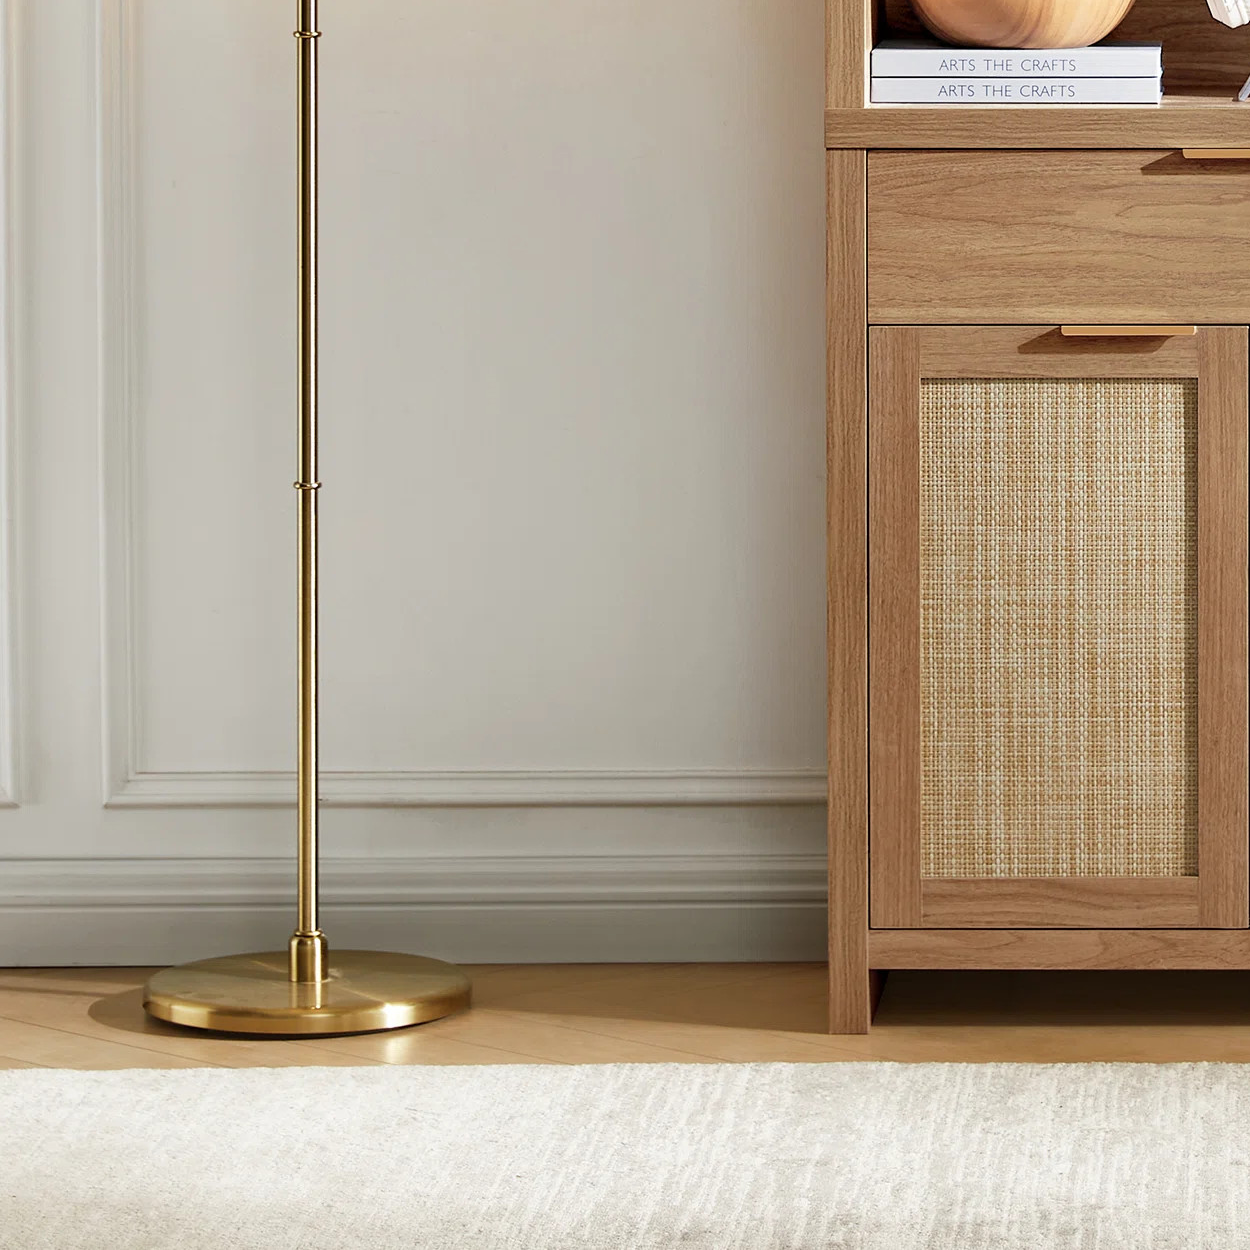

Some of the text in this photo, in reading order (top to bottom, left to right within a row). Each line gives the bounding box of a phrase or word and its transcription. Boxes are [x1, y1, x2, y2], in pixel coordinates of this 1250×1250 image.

[939, 59, 1076, 72] ARTS THE CRAFTS
[938, 85, 1075, 97] ARTS THE CRAFTS
